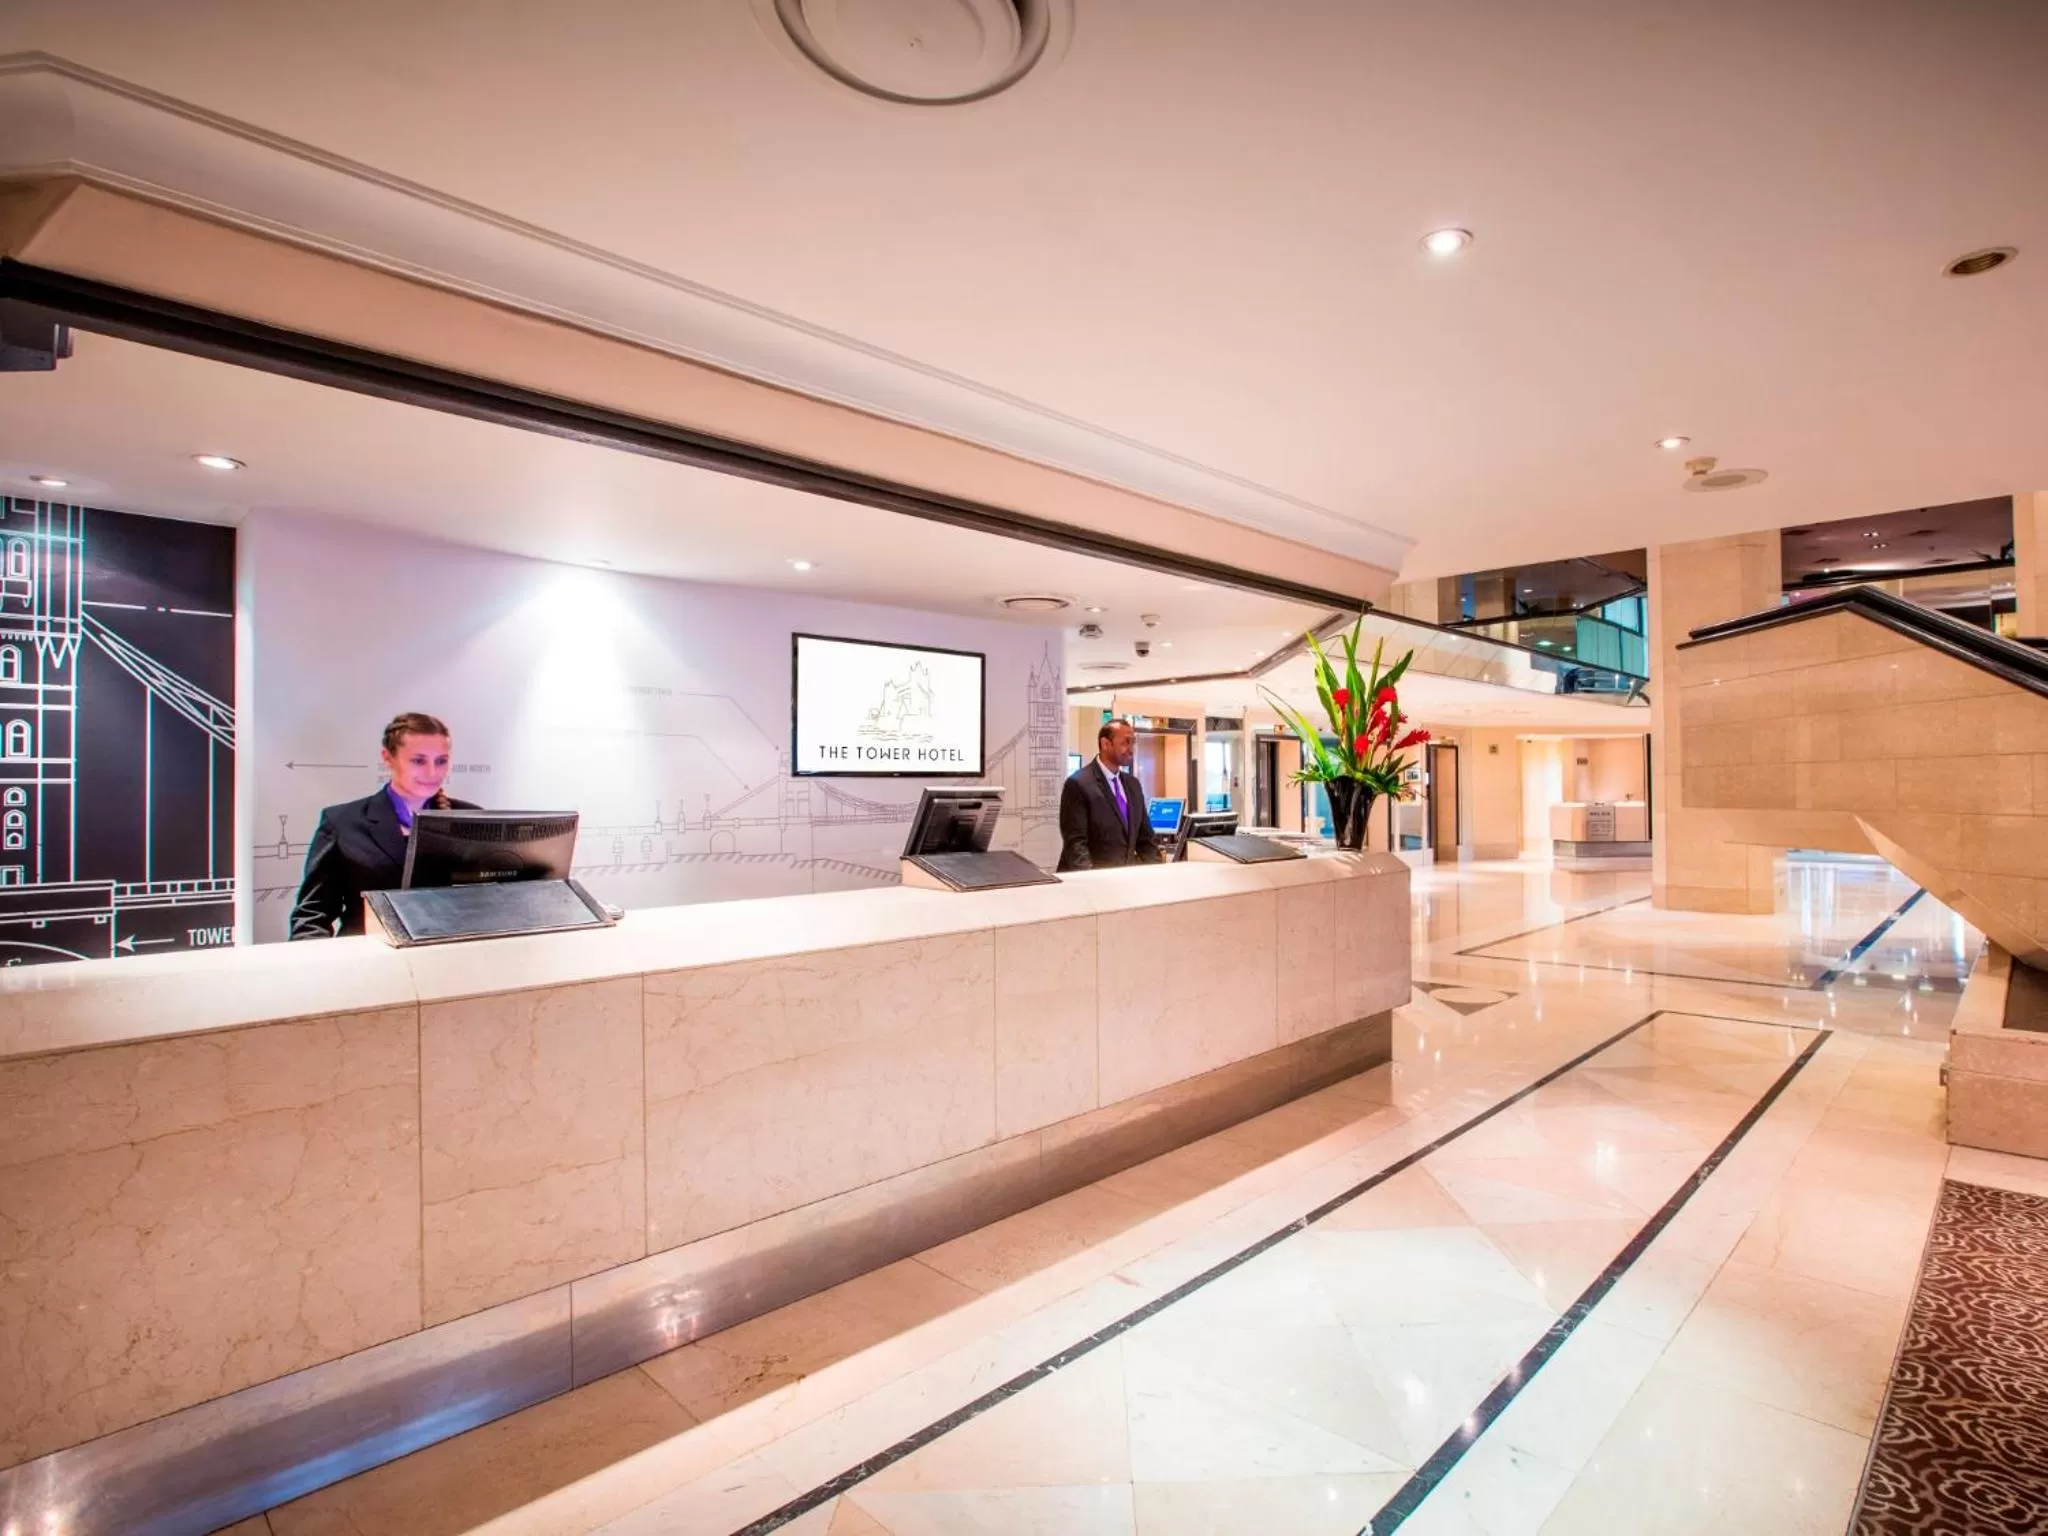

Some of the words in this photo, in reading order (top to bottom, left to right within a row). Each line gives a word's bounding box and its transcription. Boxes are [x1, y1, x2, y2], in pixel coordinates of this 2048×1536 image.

[819, 745, 849, 759] THE
[856, 746, 911, 760] TOWER
[918, 748, 964, 761] HOTEL
[187, 926, 235, 946] TOWE
